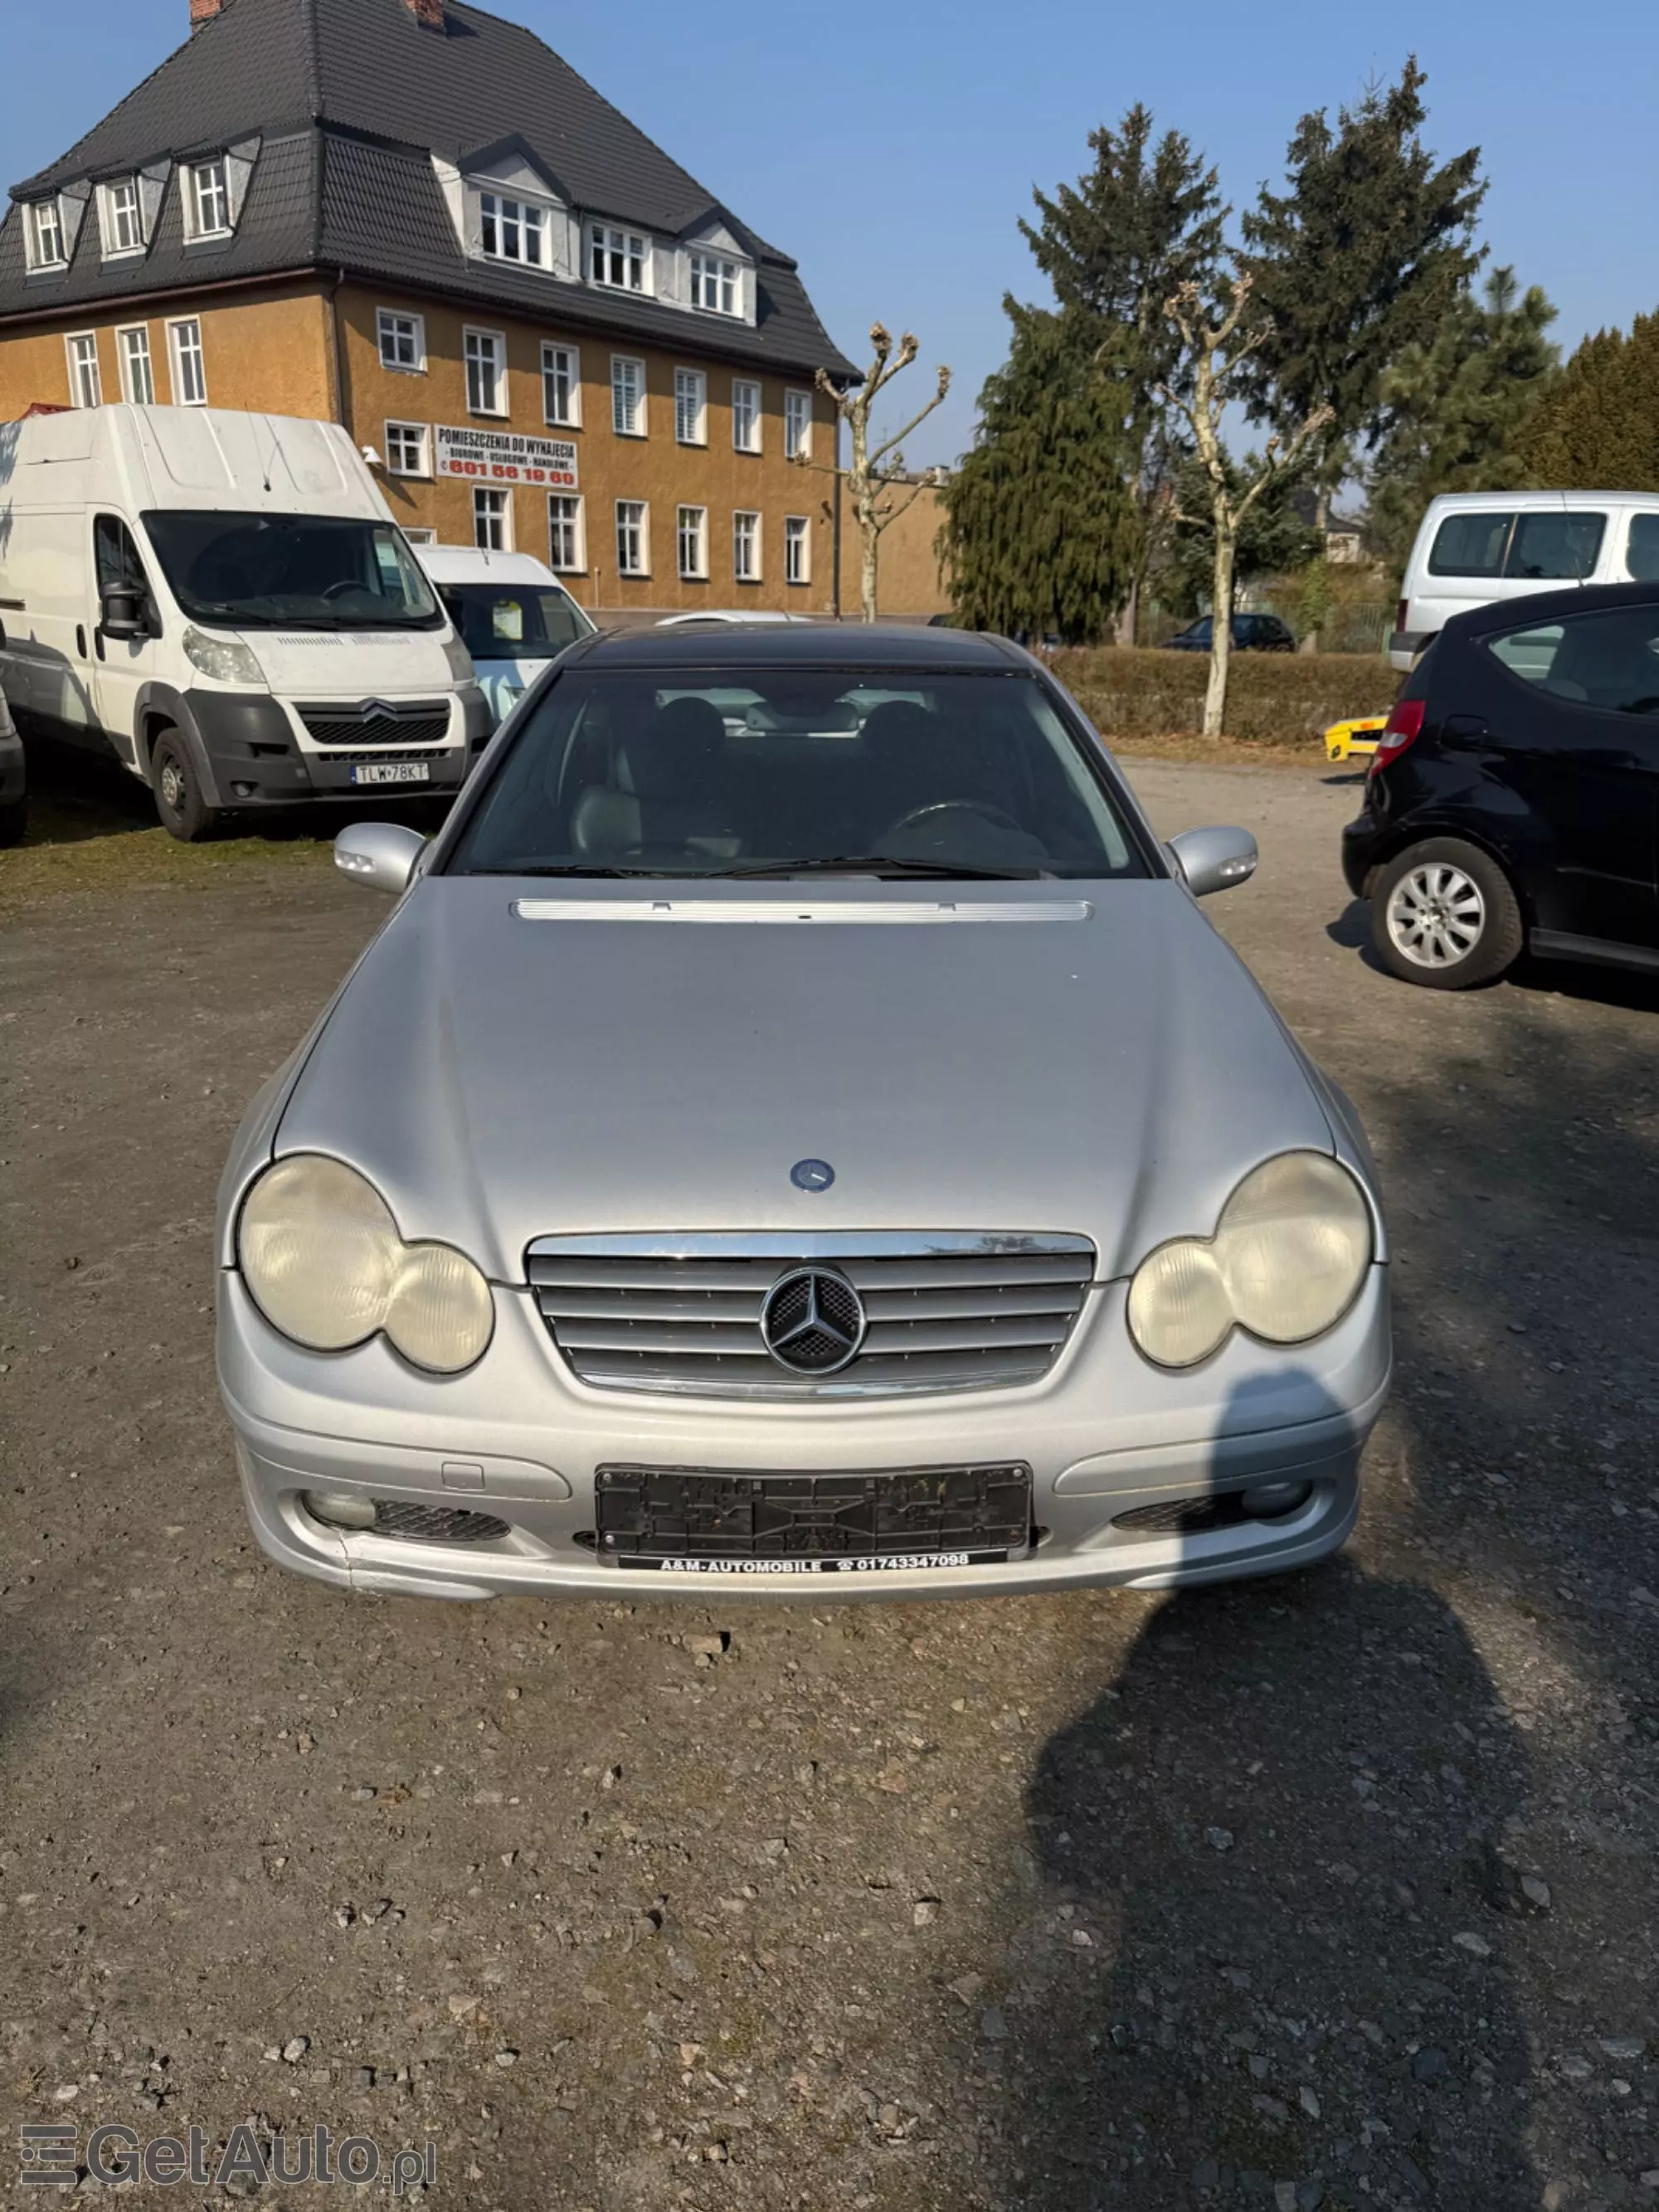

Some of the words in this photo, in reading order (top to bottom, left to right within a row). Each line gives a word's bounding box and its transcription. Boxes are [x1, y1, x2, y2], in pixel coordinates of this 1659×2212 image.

[439, 428, 510, 451] POMIESZCZENIA
[512, 438, 524, 452] DO
[449, 460, 487, 476] 601
[358, 766, 387, 782] TLW
[392, 765, 425, 780] 78KT
[660, 1558, 822, 1573] A&M-AUTOMOBILE
[857, 1553, 969, 1571] 01743347098
